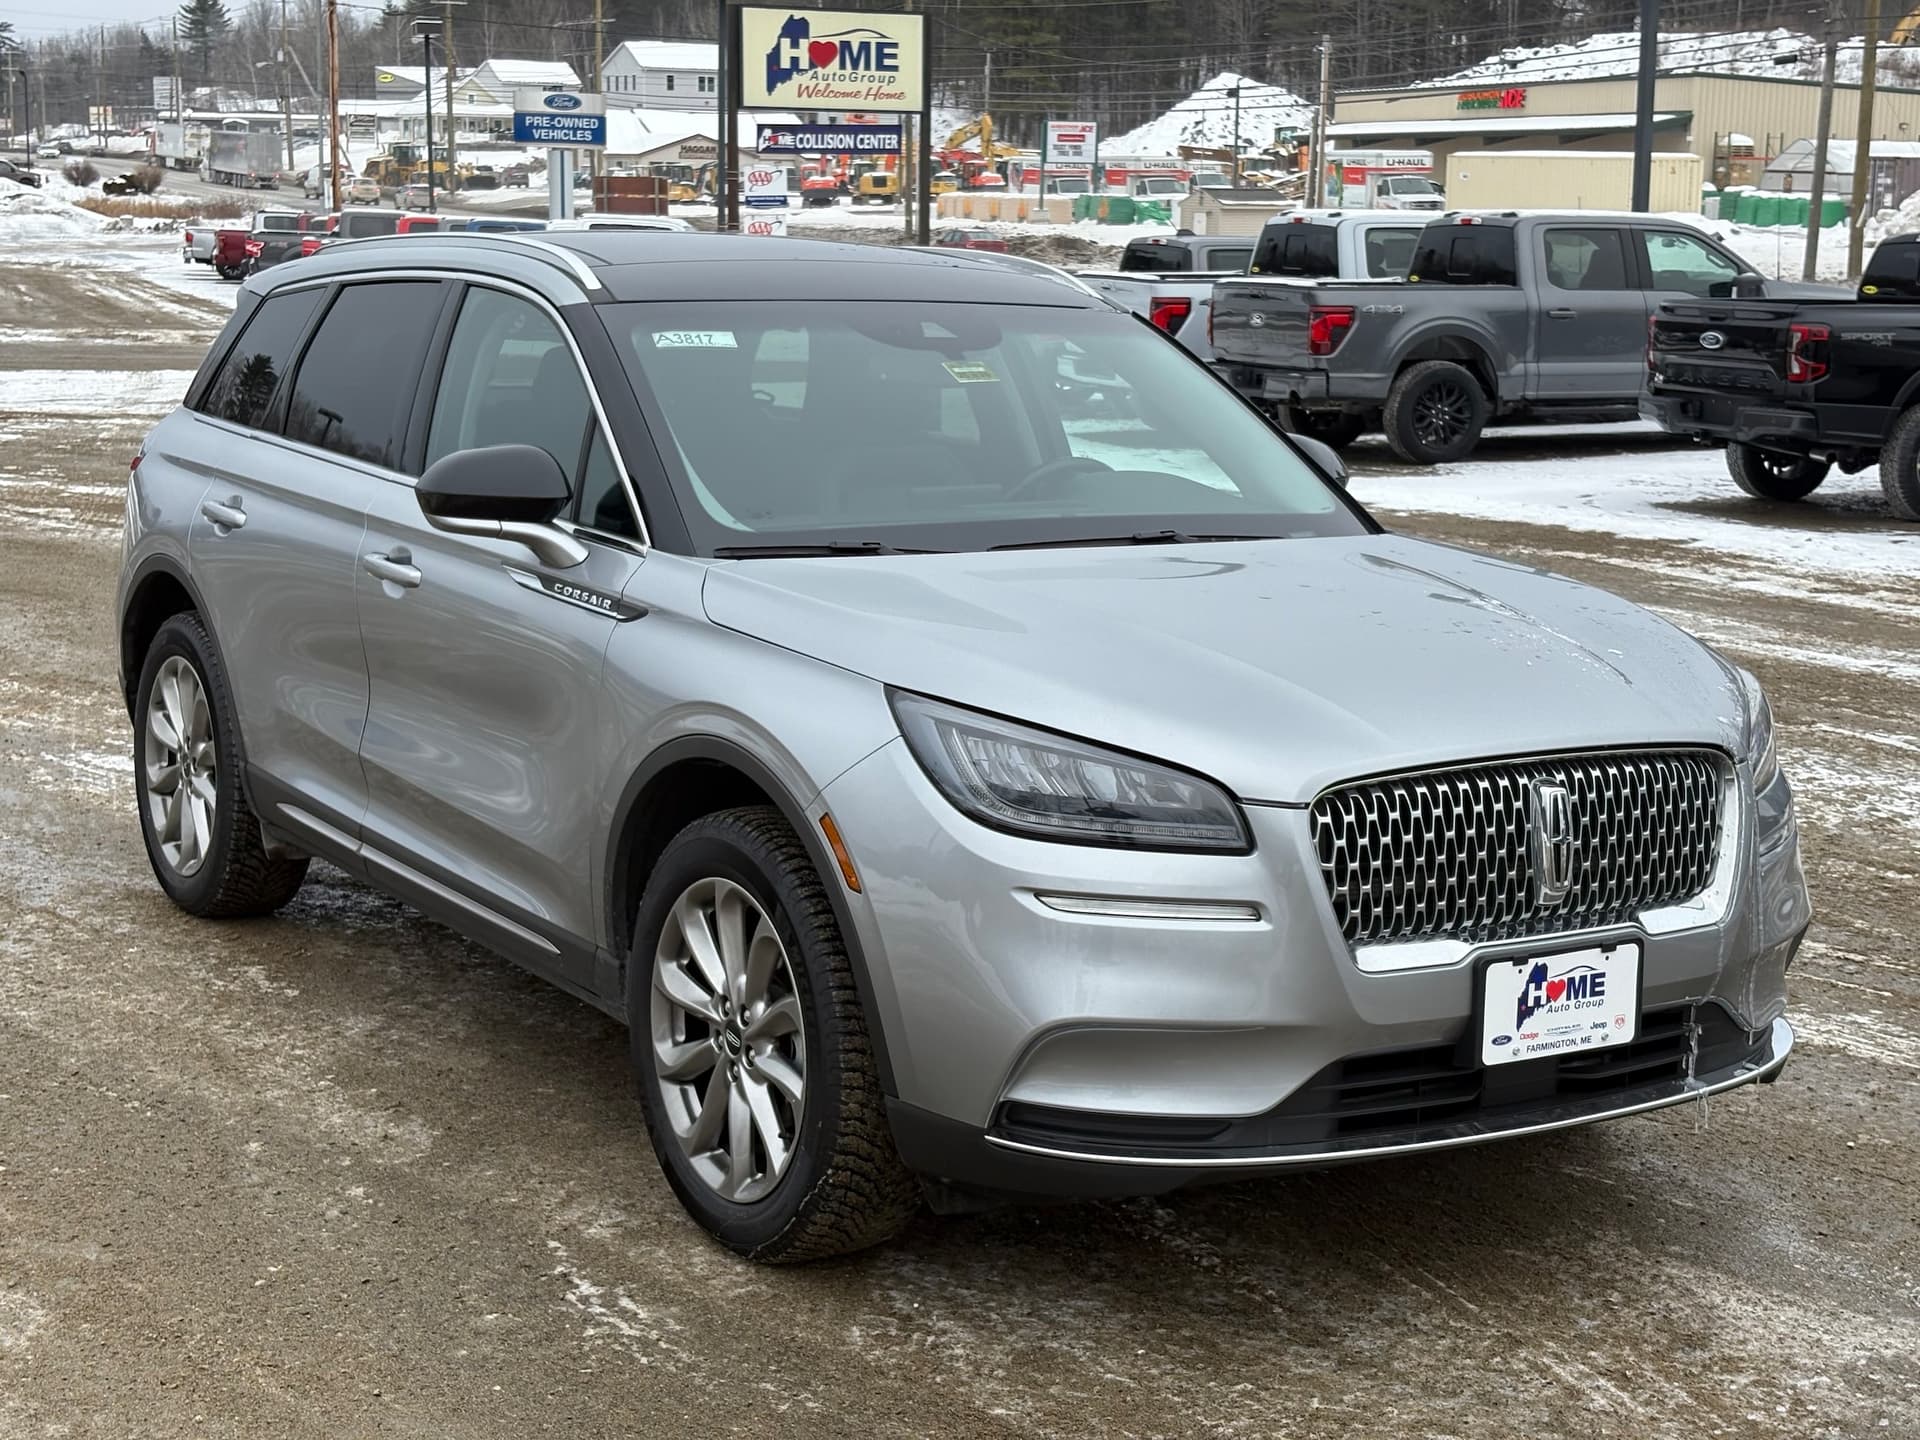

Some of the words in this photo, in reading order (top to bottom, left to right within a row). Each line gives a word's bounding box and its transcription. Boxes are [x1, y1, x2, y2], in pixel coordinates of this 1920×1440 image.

[797, 83, 863, 99] Welcome
[864, 85, 906, 101] Home
[525, 116, 598, 129] PRE-OWNED
[532, 129, 592, 141] VEHICLES
[796, 134, 854, 149] COLLISION
[856, 134, 898, 149] CENTER
[656, 333, 713, 345] A3817
[1840, 332, 1897, 341] SPORT
[554, 583, 612, 610] CORSAIR
[1546, 1003, 1570, 1014] Auto
[1574, 999, 1604, 1010] Group
[1589, 1021, 1608, 1031] Jeep
[1519, 1031, 1539, 1041] Dodge
[1526, 1038, 1579, 1053] FARMINGTON,
[1580, 1035, 1593, 1045] ME
